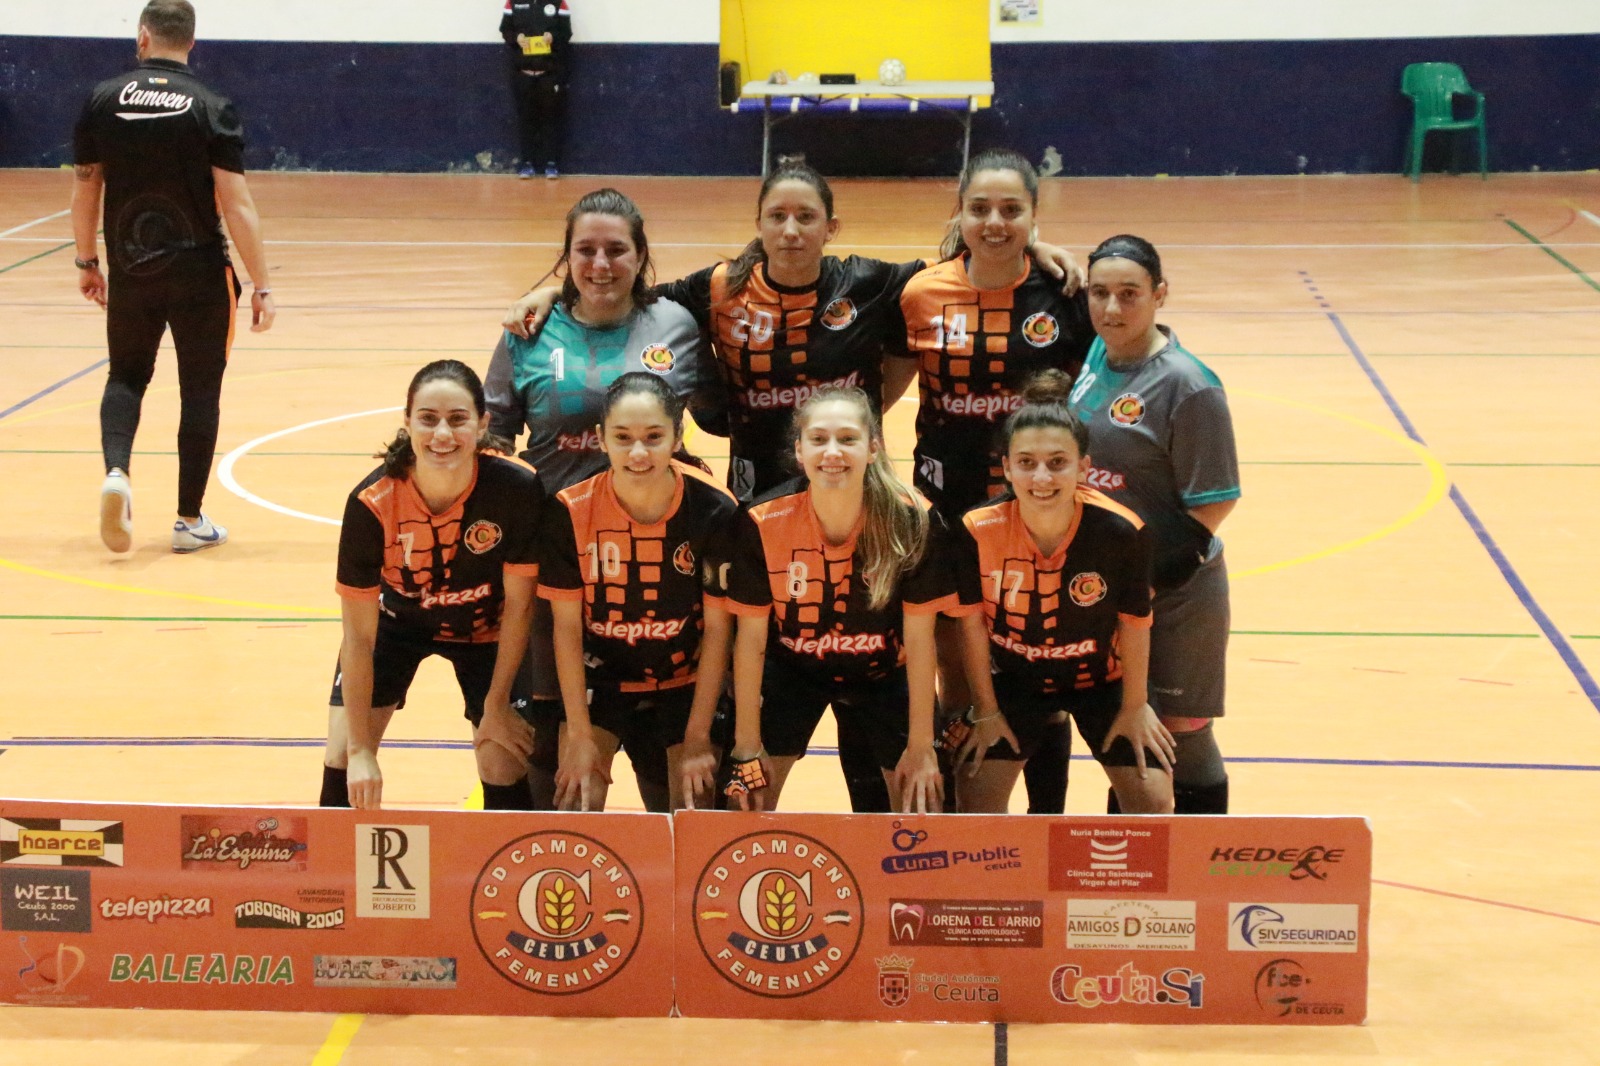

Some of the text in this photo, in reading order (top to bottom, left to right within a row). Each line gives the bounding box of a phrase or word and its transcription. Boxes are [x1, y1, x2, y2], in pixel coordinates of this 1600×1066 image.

[118, 81, 194, 112] Camoens
[730, 306, 774, 344] 20
[929, 313, 969, 349] 14
[550, 347, 565, 381] 1
[941, 392, 1024, 421] telepiz
[397, 532, 415, 567] 7
[584, 541, 621, 580] 10
[787, 560, 808, 598] 8
[988, 569, 1025, 608] 17
[779, 629, 884, 657] elepizza
[22, 834, 102, 851] hoarce
[183, 835, 294, 869] La Esquina
[511, 839, 631, 899] CAMOENS
[731, 839, 851, 900] CAMOENS
[892, 846, 1021, 871] Luna Public
[984, 861, 1022, 871] ceuta
[1079, 879, 1106, 888] Virgen
[1121, 879, 1141, 887] Pilar
[1108, 870, 1153, 878] fisioterapia
[14, 884, 79, 901] WEIL
[17, 901, 76, 911] Ceuta 2000
[372, 902, 416, 911] ROBERTO
[99, 895, 211, 923] telepizza
[234, 900, 344, 929] TOBOGAN 2000
[927, 914, 1041, 928] LORENA DEL BARRIO
[1067, 920, 1120, 933] AMIGOS
[1145, 921, 1196, 934] SOLANO
[523, 937, 597, 960] CEUTA
[744, 939, 818, 962] CEUTA
[495, 944, 621, 987] FEMENINO
[717, 946, 842, 990] FEMENINO
[915, 973, 948, 983] Ciudad
[915, 983, 999, 1002] de Ceuta
[1295, 1006, 1345, 1015] DE CEUTA
